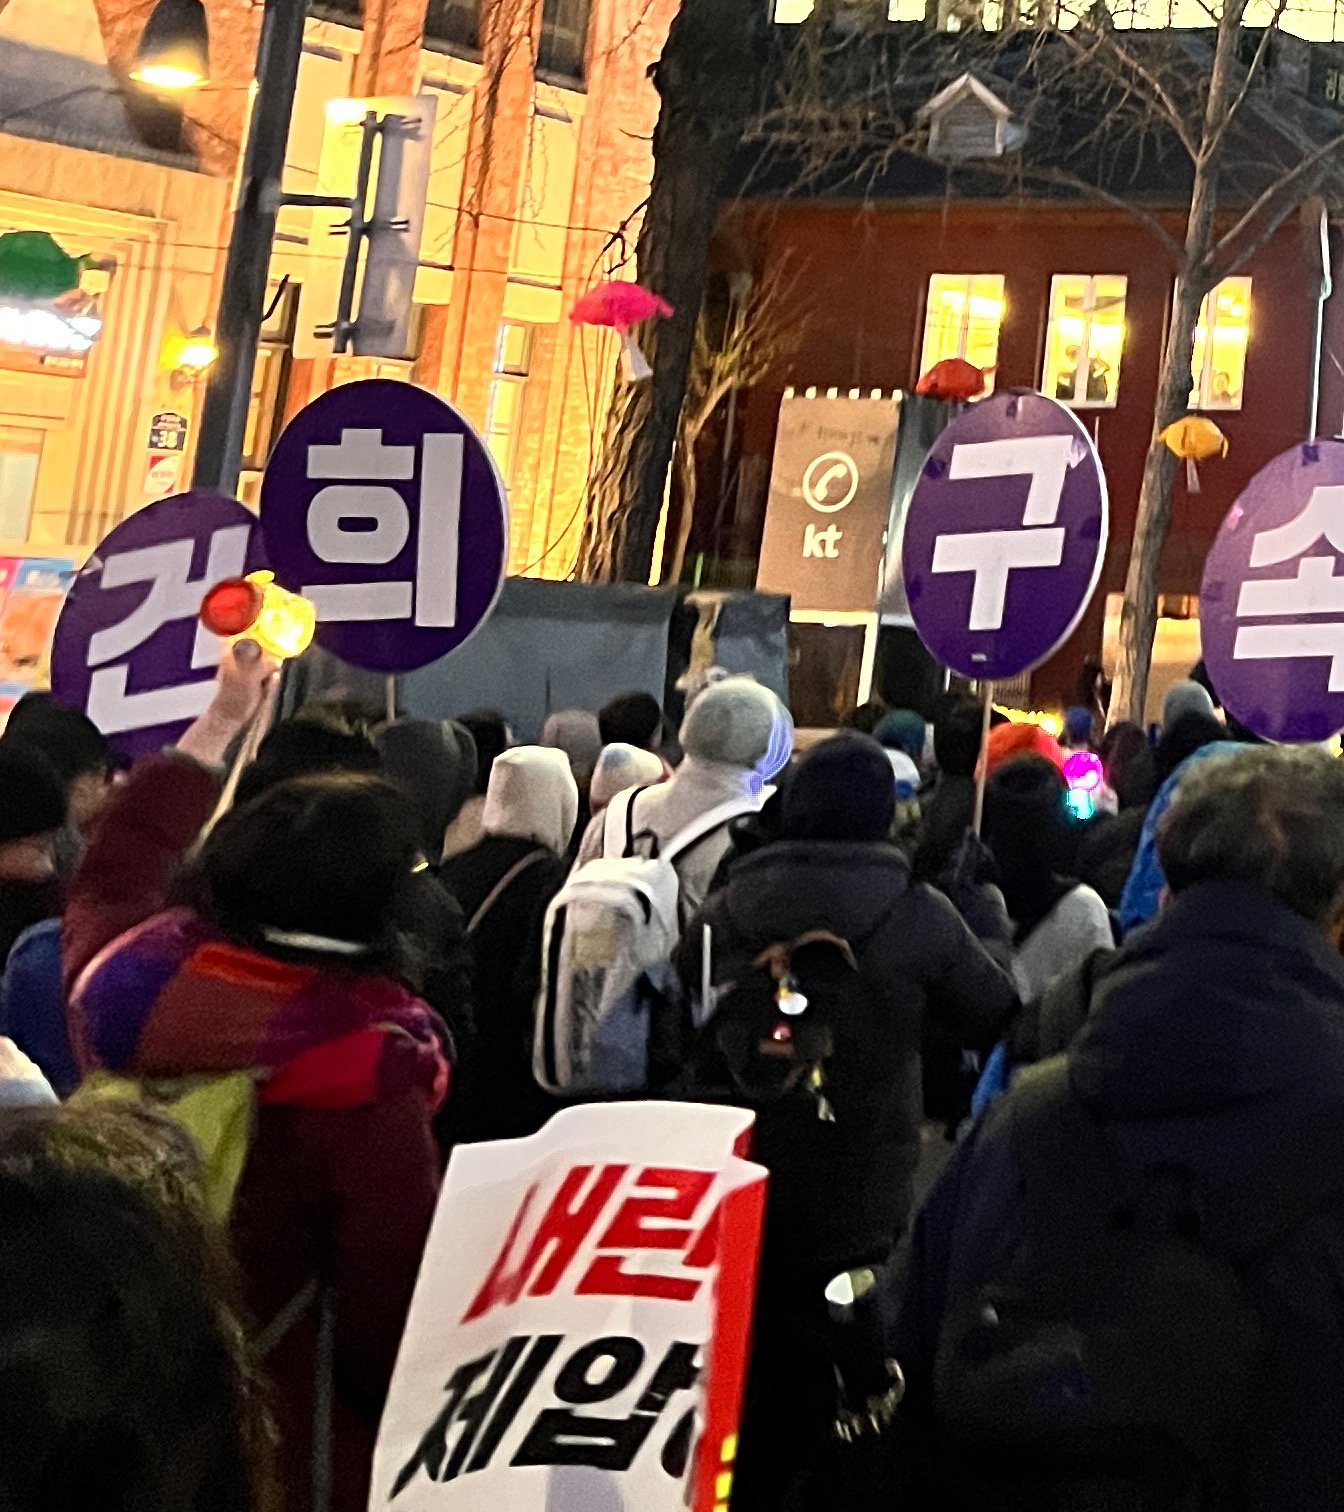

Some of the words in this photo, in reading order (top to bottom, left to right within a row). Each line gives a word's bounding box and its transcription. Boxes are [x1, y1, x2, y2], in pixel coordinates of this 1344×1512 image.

[301, 428, 465, 629] 희
[802, 523, 843, 558] kt
[931, 434, 1075, 632] 구
[459, 1163, 719, 1326] 내란
[388, 1334, 706, 1504] 제압
